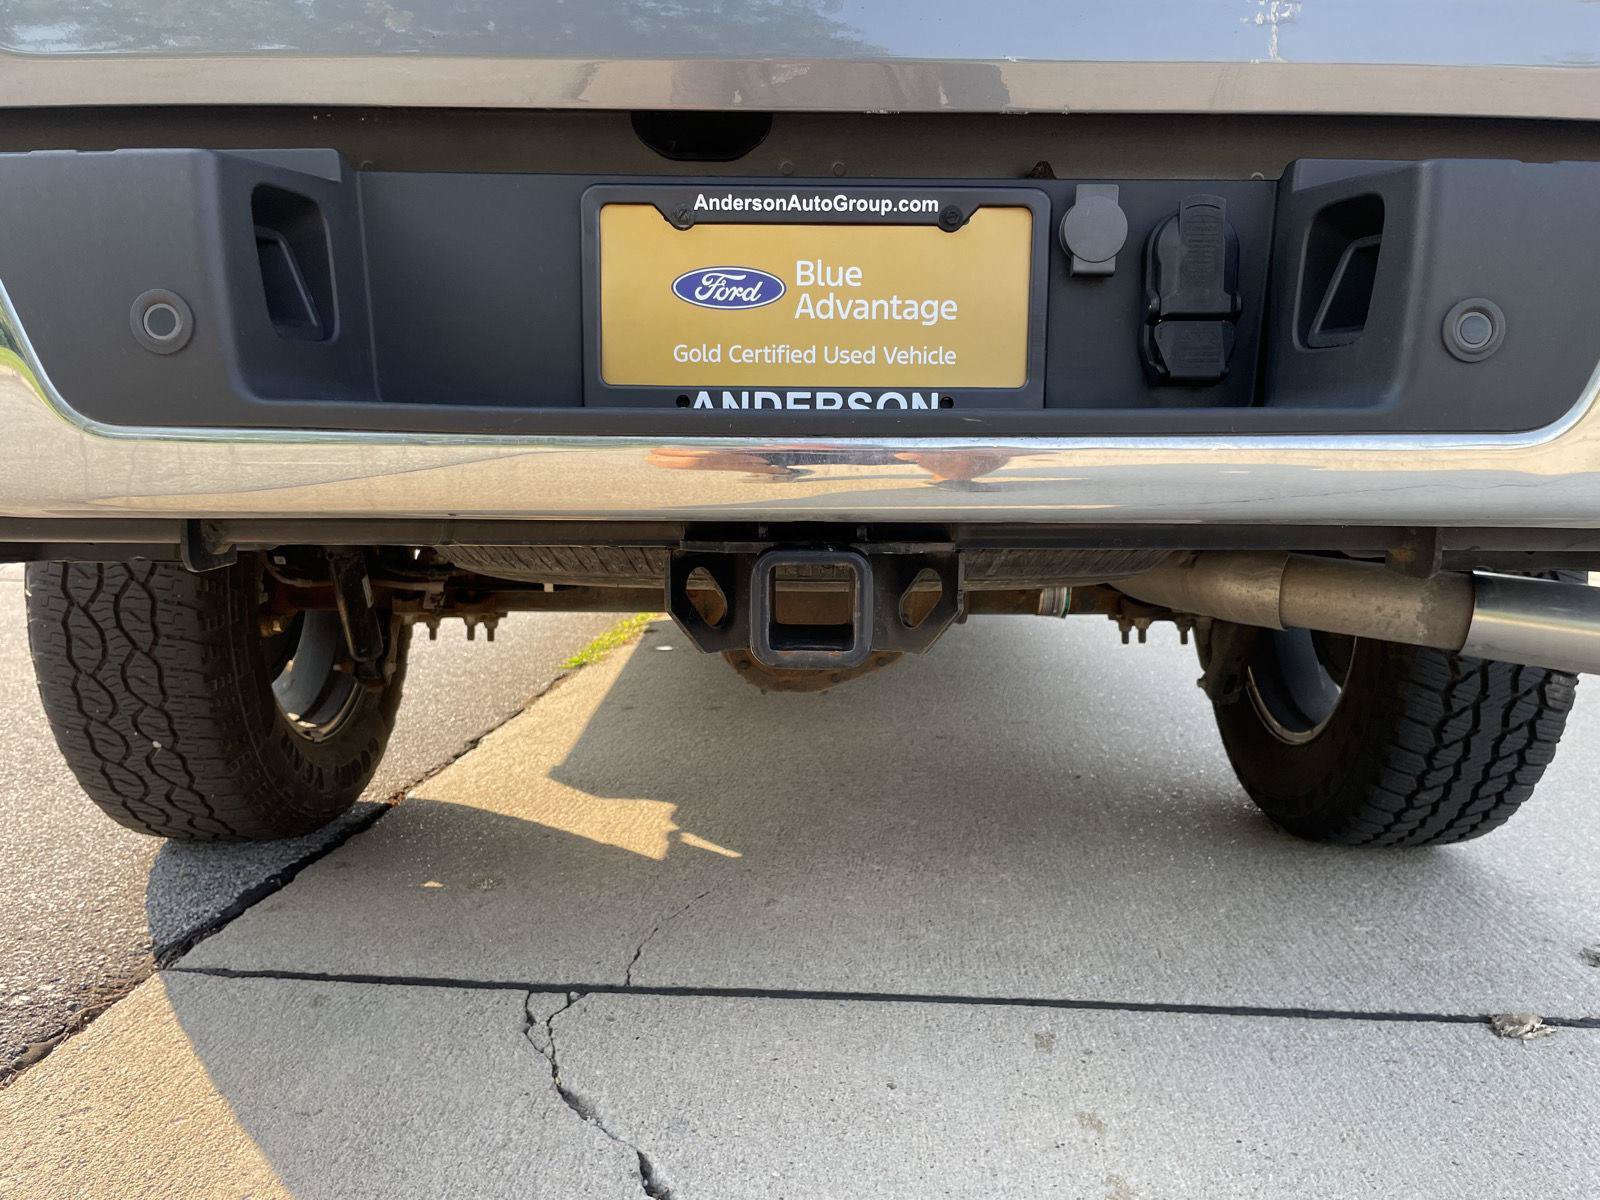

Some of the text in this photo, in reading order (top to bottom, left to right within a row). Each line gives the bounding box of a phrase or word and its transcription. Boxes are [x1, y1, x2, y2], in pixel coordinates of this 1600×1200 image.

[693, 193, 939, 216] AndersonAutoGroup.com
[694, 272, 763, 302] Ford
[796, 259, 863, 288] Blue
[794, 293, 959, 327] Advantage
[673, 343, 957, 367] Gold Certified Used Vehicle
